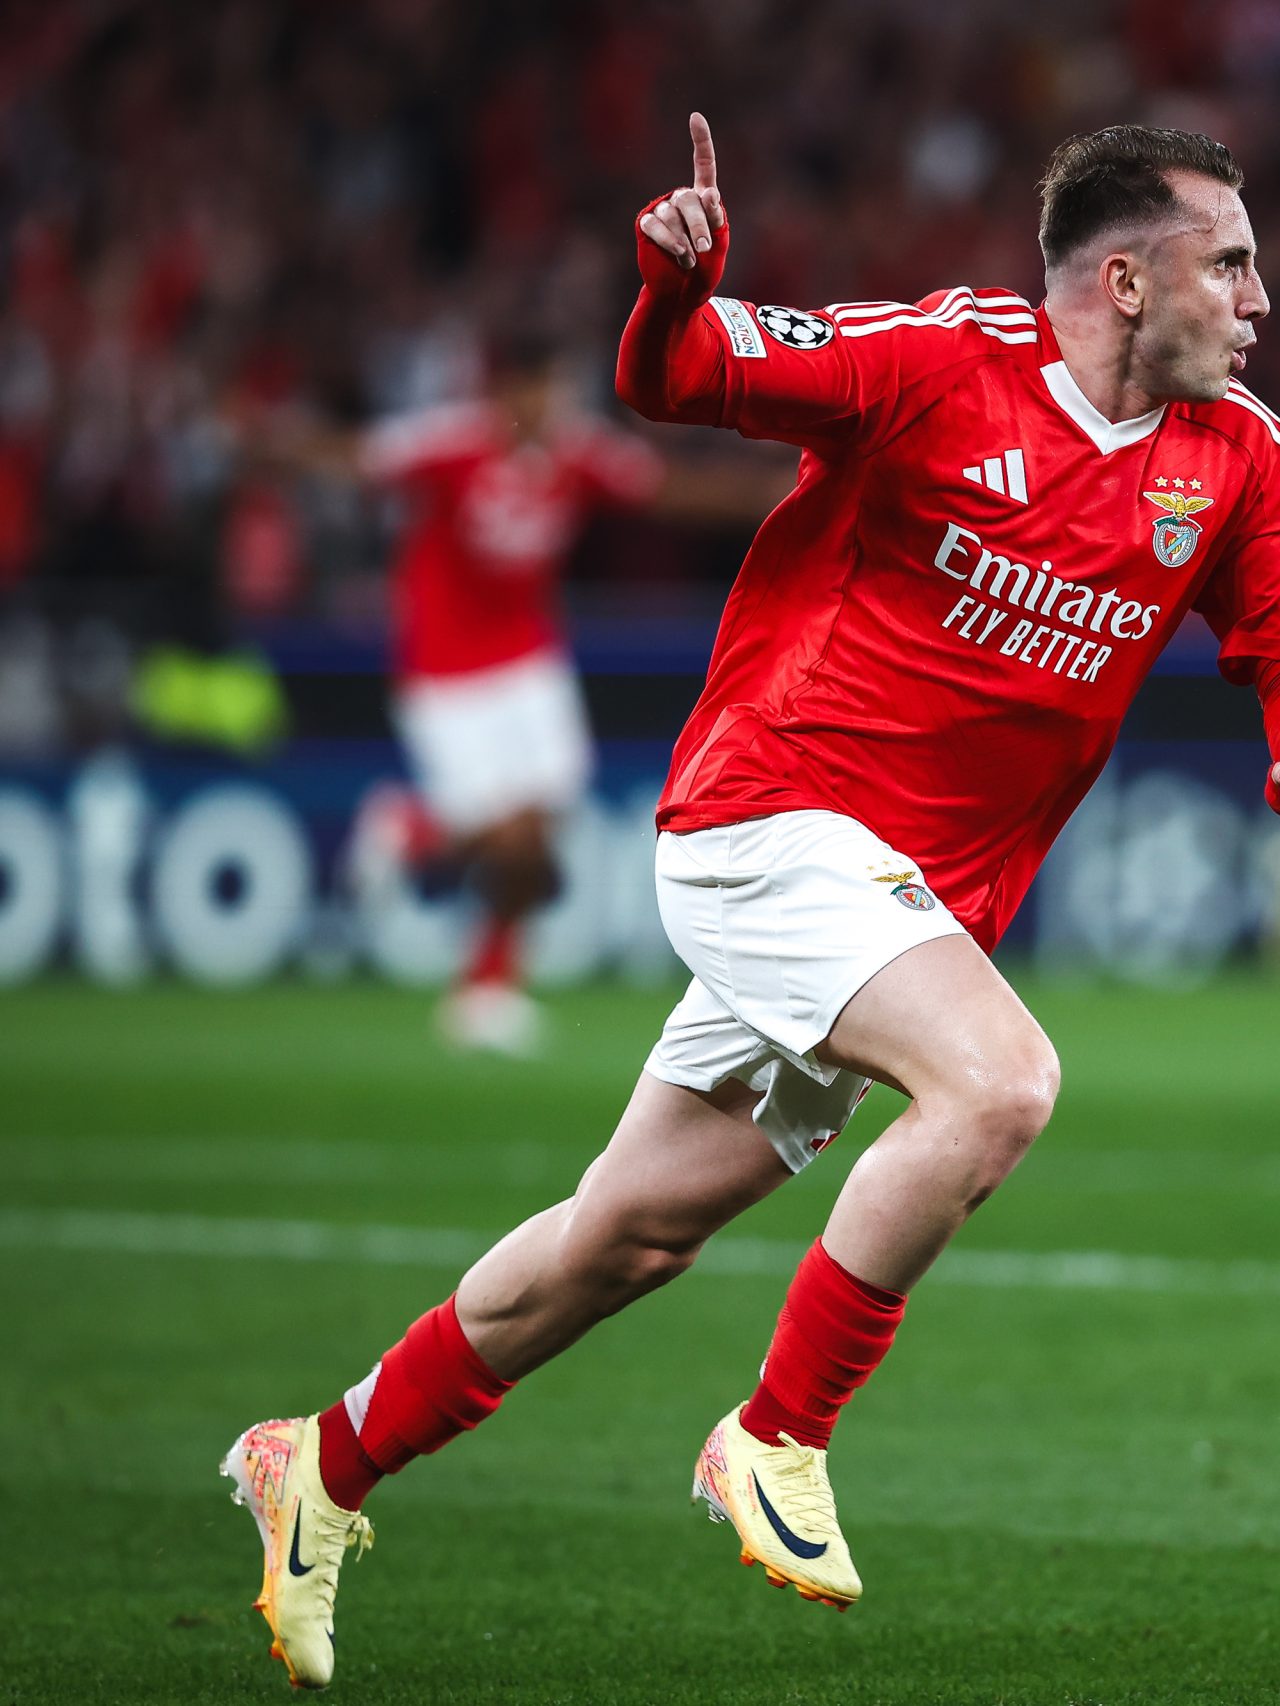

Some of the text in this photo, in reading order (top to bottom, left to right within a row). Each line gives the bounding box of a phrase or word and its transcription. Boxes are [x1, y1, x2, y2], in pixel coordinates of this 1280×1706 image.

[934, 521, 1161, 641] Emirates
[941, 594, 1113, 684] FLY BETTER
